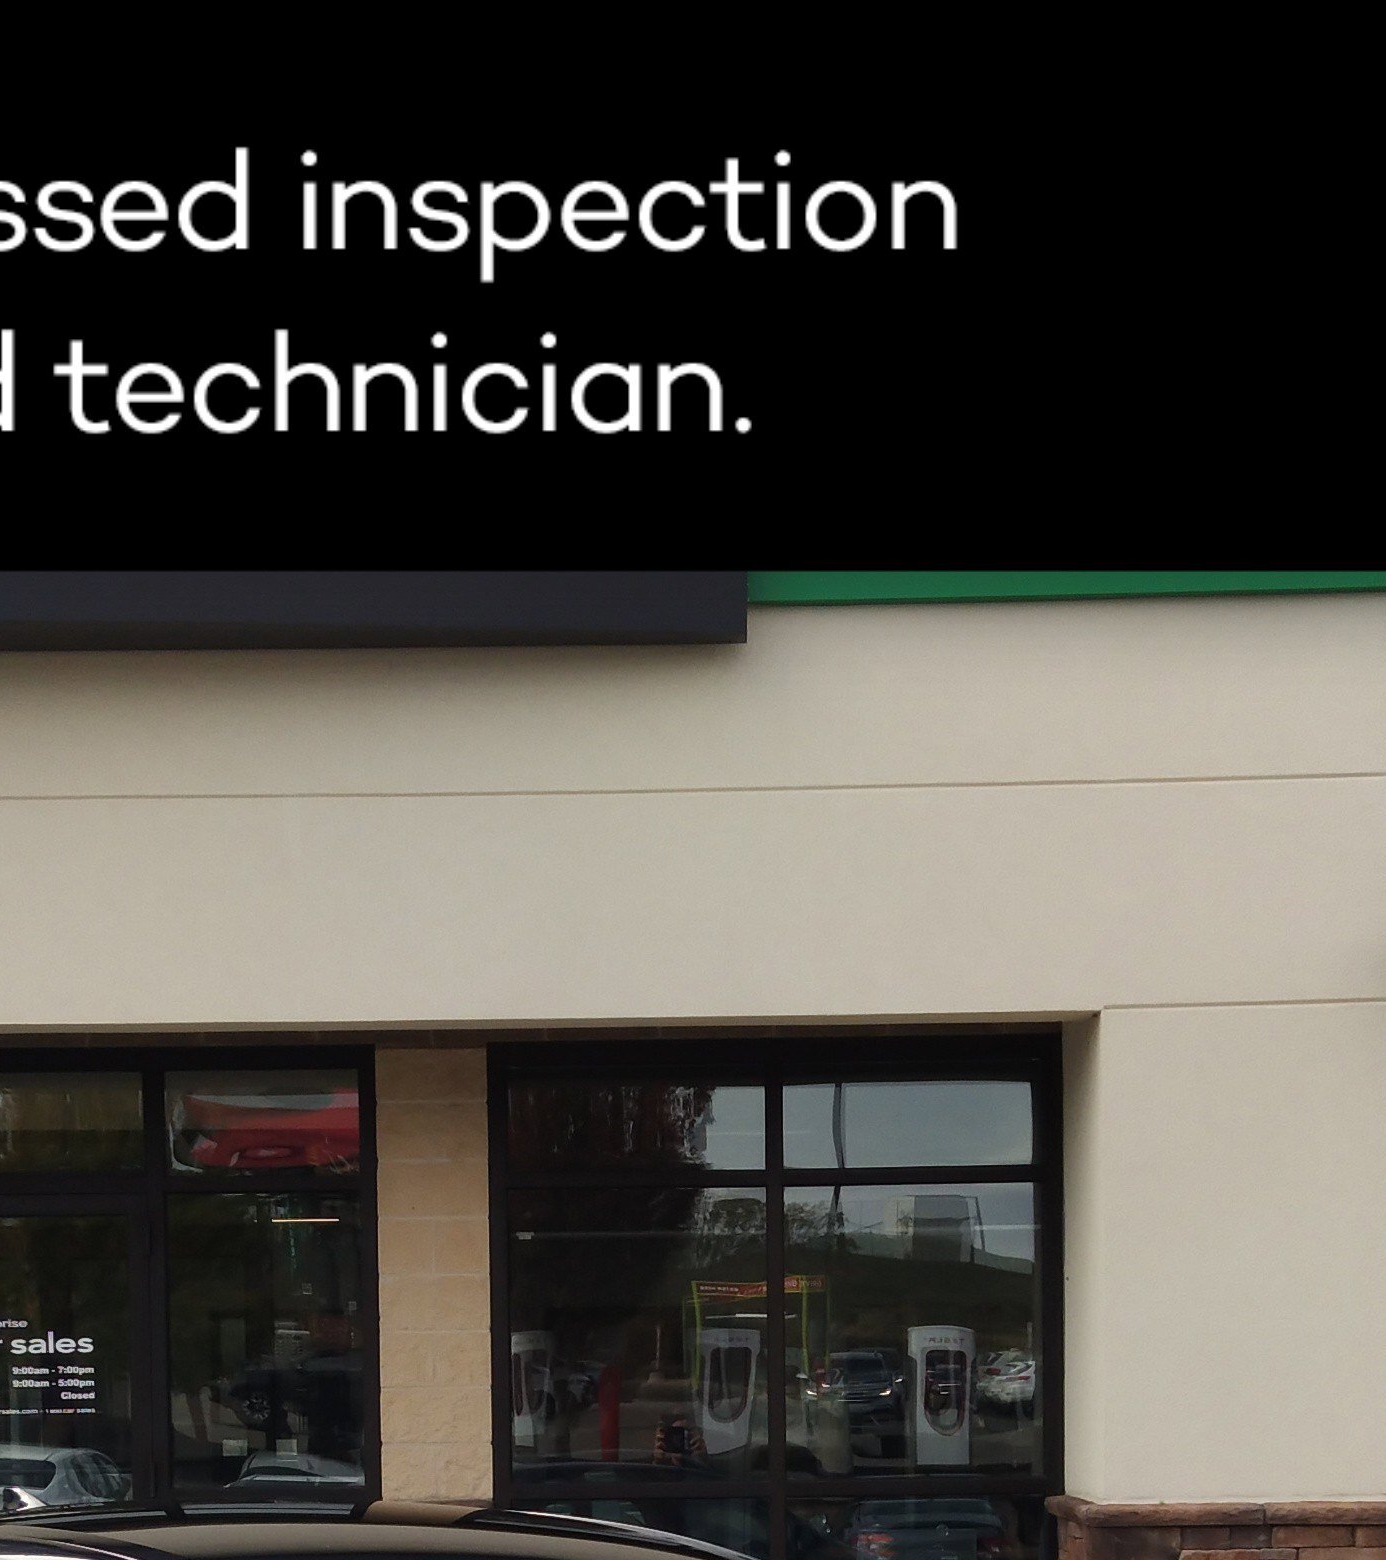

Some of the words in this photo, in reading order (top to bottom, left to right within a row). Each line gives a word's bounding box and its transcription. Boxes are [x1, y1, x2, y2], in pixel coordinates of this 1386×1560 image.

[10, 1331, 94, 1354] sales
[12, 1366, 50, 1375] 9:00am
[57, 1365, 95, 1376] 7:00pm
[12, 1379, 50, 1388] 9:00am
[60, 1391, 96, 1400] Closed
